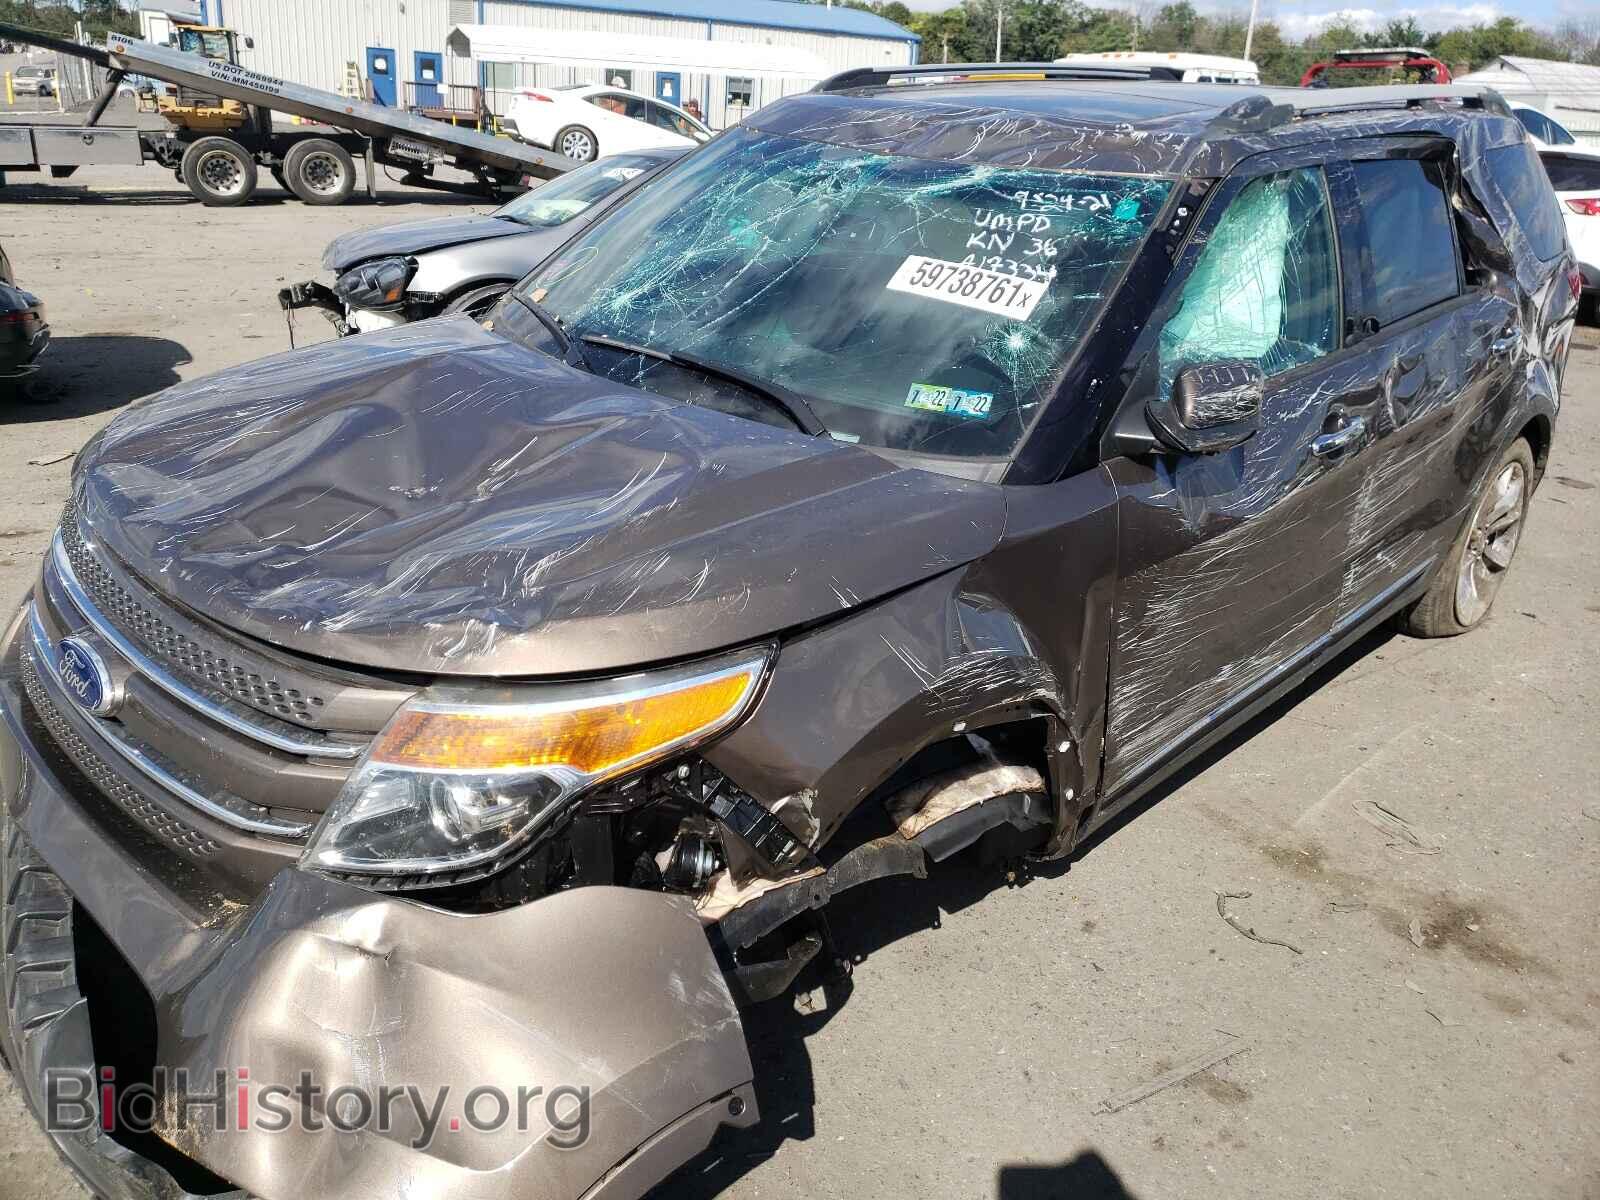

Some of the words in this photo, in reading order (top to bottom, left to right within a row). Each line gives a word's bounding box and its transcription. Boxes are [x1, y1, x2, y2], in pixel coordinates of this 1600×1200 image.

[208, 61, 220, 70] US
[223, 64, 243, 75] DOT
[211, 70, 231, 81] VIN:
[1023, 238, 1058, 257] 36
[909, 260, 1025, 307] 59738761
[931, 390, 947, 407] 22
[60, 649, 86, 698] Ford
